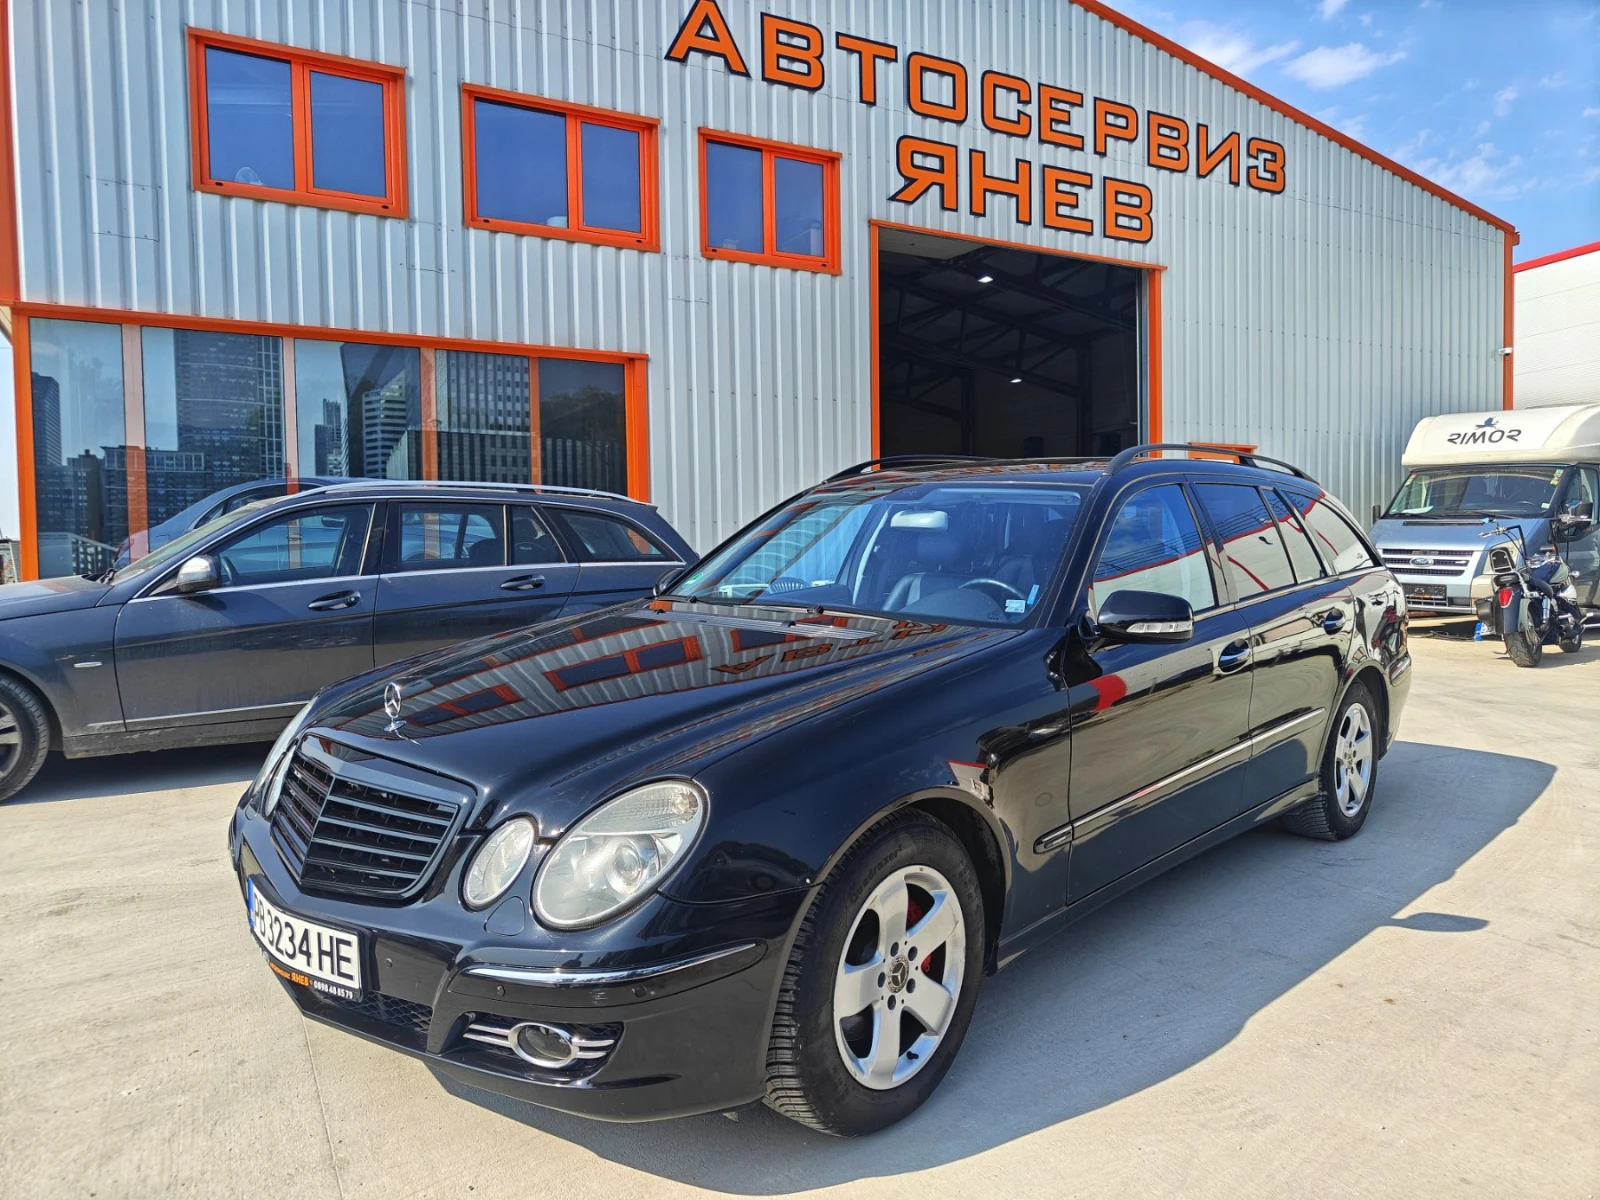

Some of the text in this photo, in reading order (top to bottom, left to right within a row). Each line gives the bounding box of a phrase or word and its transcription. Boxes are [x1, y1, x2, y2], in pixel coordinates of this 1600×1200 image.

[664, 0, 1287, 195] АВТОСЕРВИЗ
[888, 134, 1154, 244] ЯНЕВ
[1446, 429, 1522, 445] RIMOR
